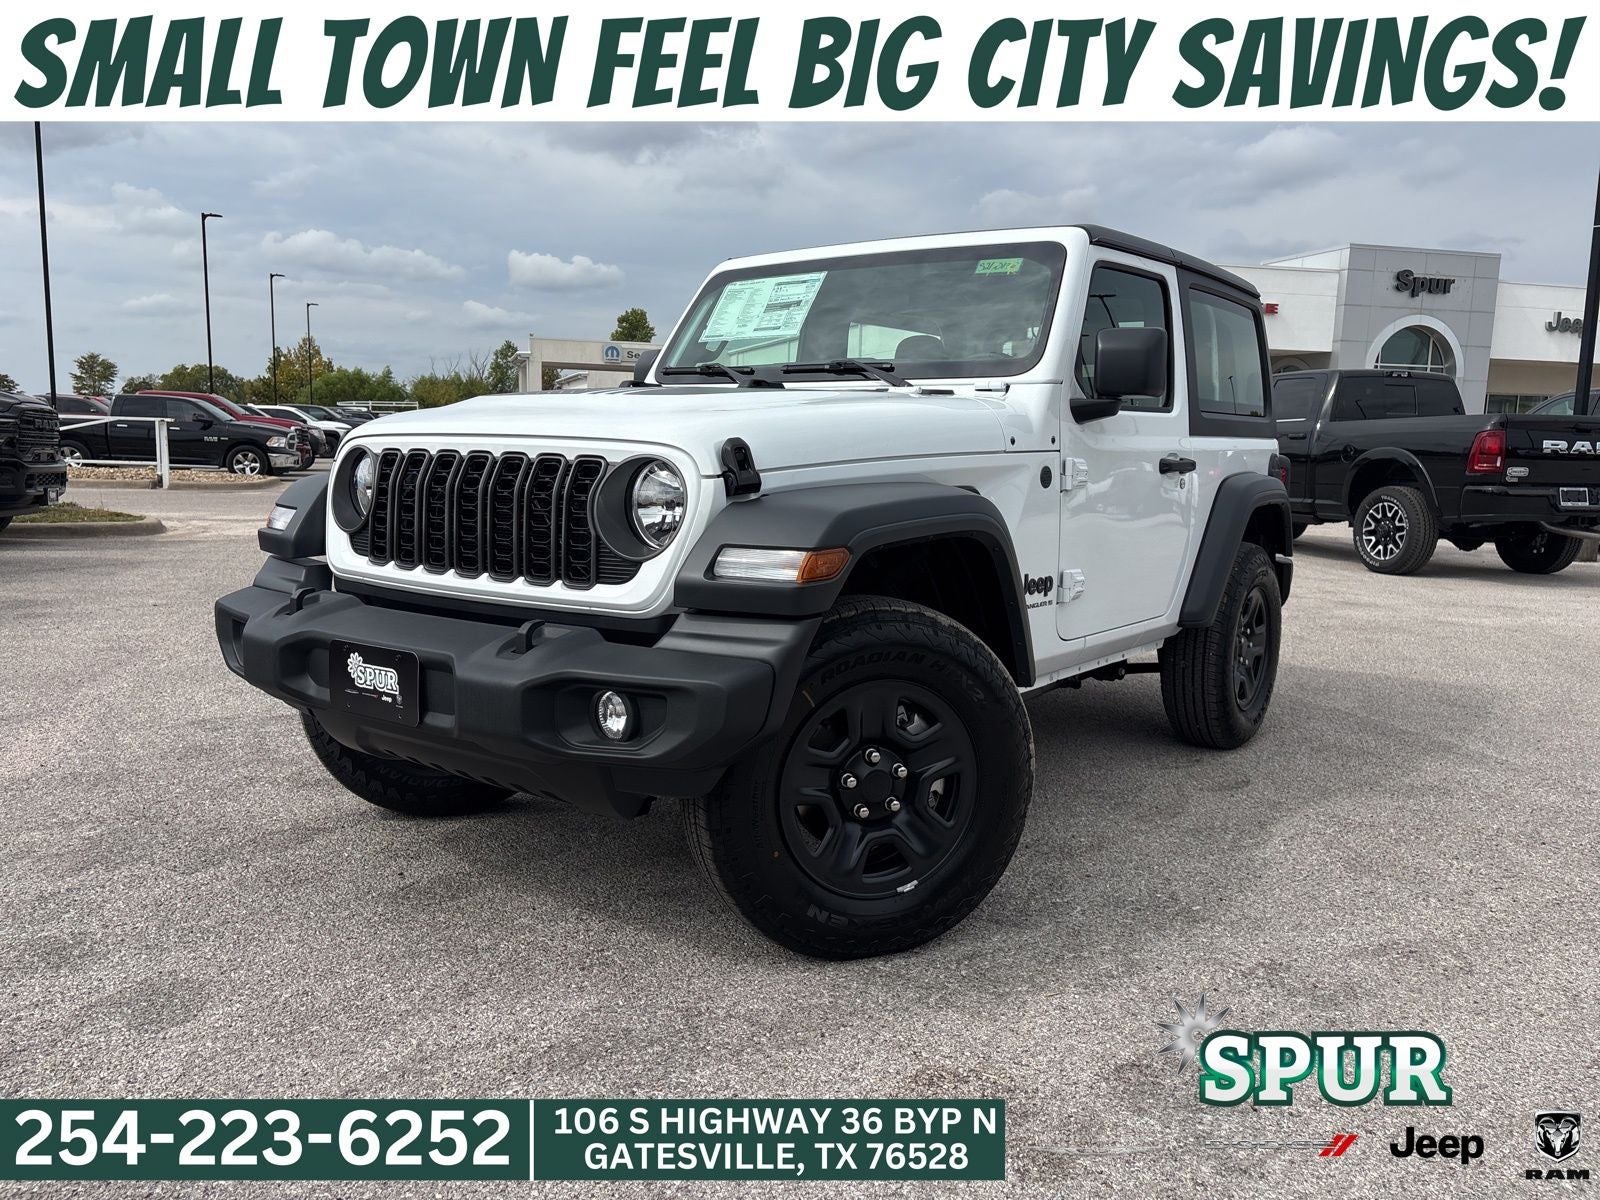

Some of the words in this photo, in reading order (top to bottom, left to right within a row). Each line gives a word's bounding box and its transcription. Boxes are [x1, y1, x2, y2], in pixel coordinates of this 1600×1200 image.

[1396, 269, 1455, 297] Spur
[1545, 311, 1584, 339] Jee
[1542, 440, 1600, 454] RA
[1024, 573, 1054, 597] Jeep
[356, 666, 397, 691] SPUR
